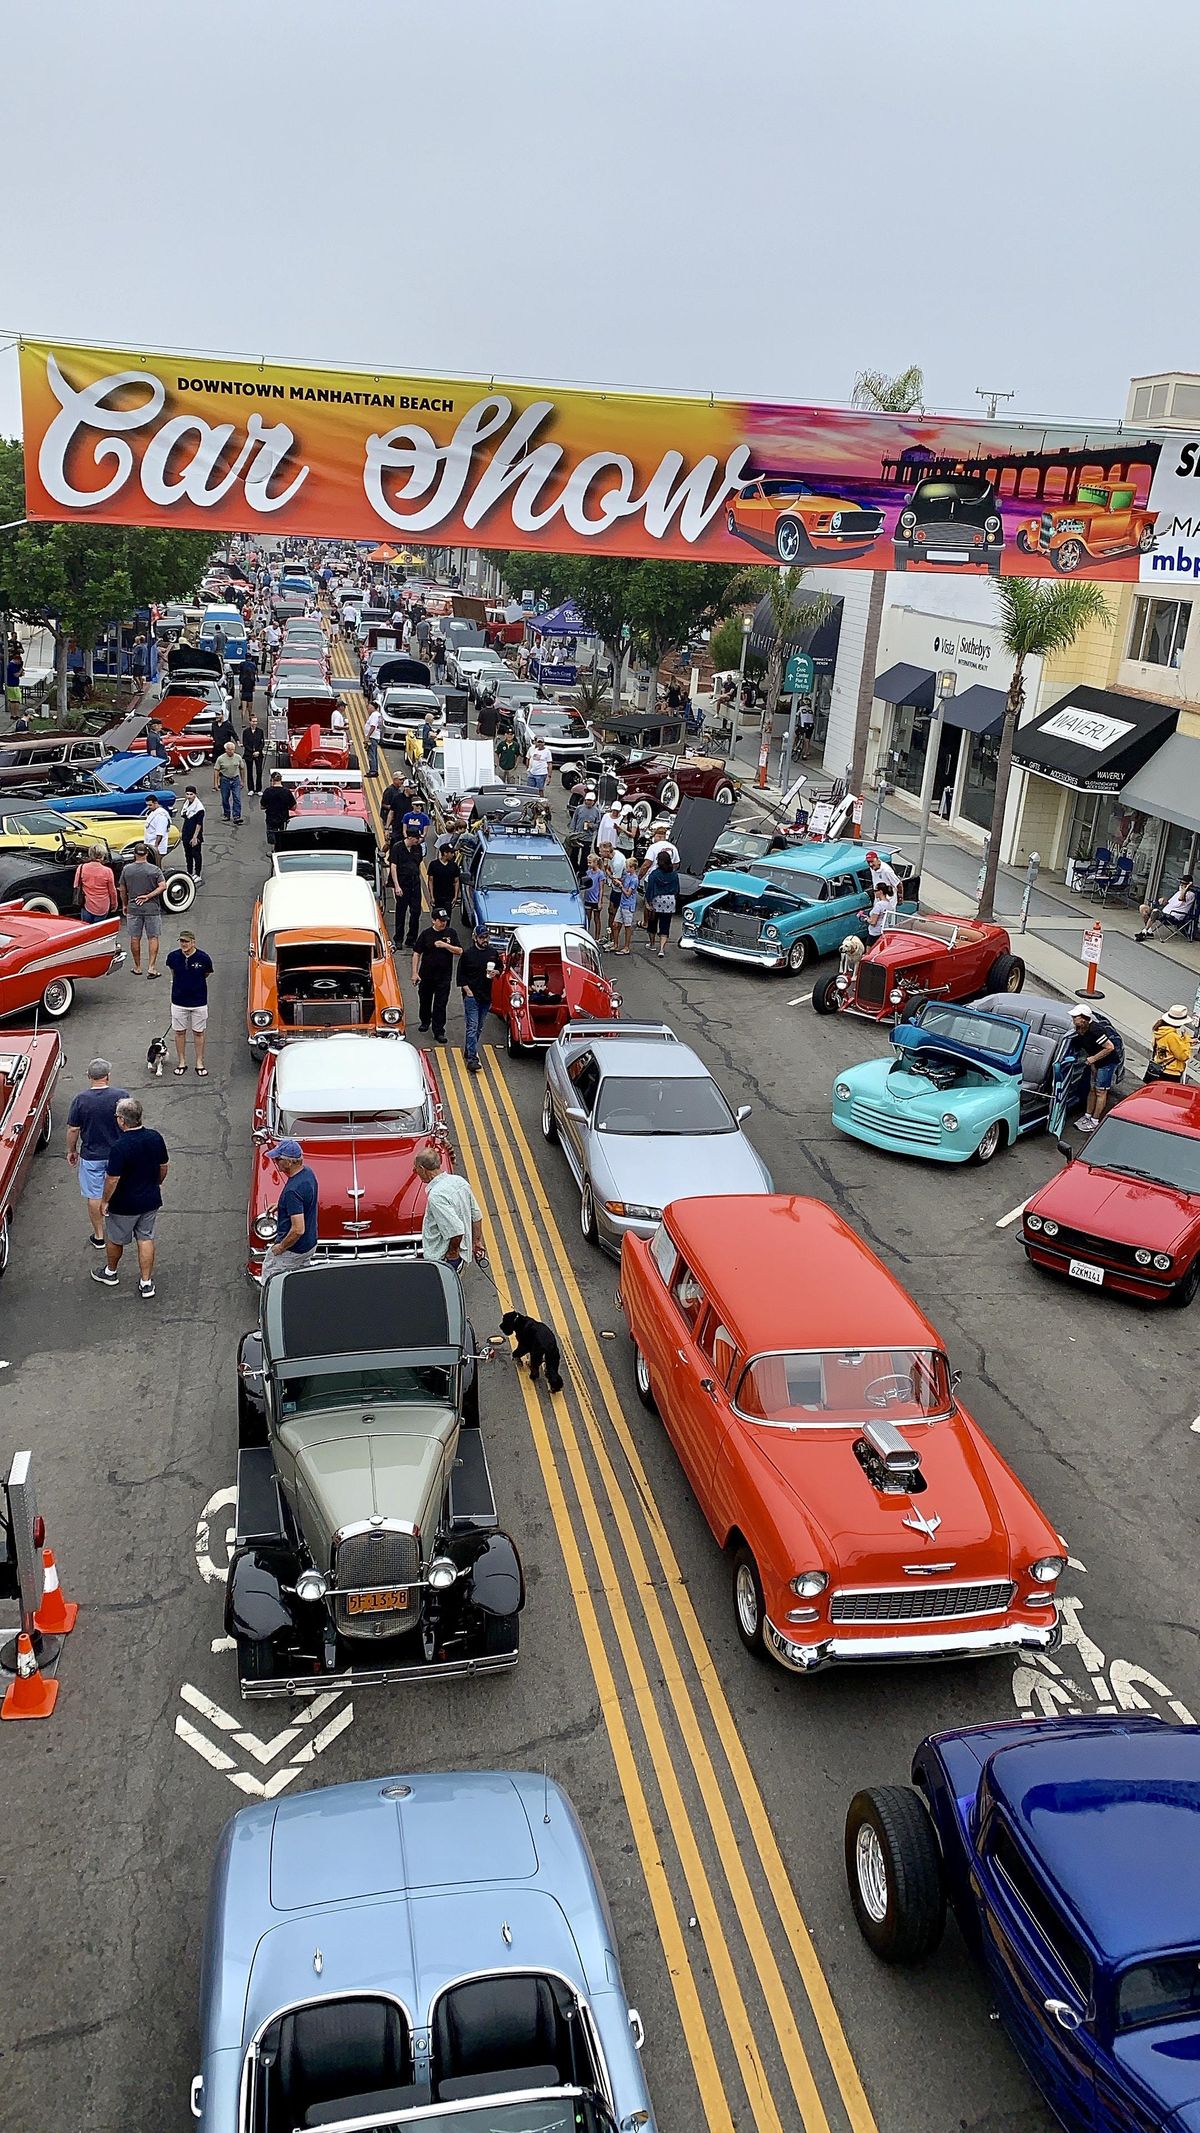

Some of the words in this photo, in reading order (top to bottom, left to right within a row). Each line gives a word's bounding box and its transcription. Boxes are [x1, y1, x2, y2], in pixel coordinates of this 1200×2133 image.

[177, 377, 285, 399] DOWNTOWN
[289, 386, 395, 408] MANHATTAN
[399, 395, 454, 413] BEACH
[38, 352, 310, 513] Car
[363, 395, 766, 544] Show
[941, 638, 955, 655] Vista
[960, 637, 992, 661] Sotheby's
[1052, 713, 1122, 742] WAVERLY
[1029, 761, 1040, 771] GIFTS
[1050, 769, 1078, 785] ACCESSORIES
[1097, 771, 1125, 780] WAVERLY
